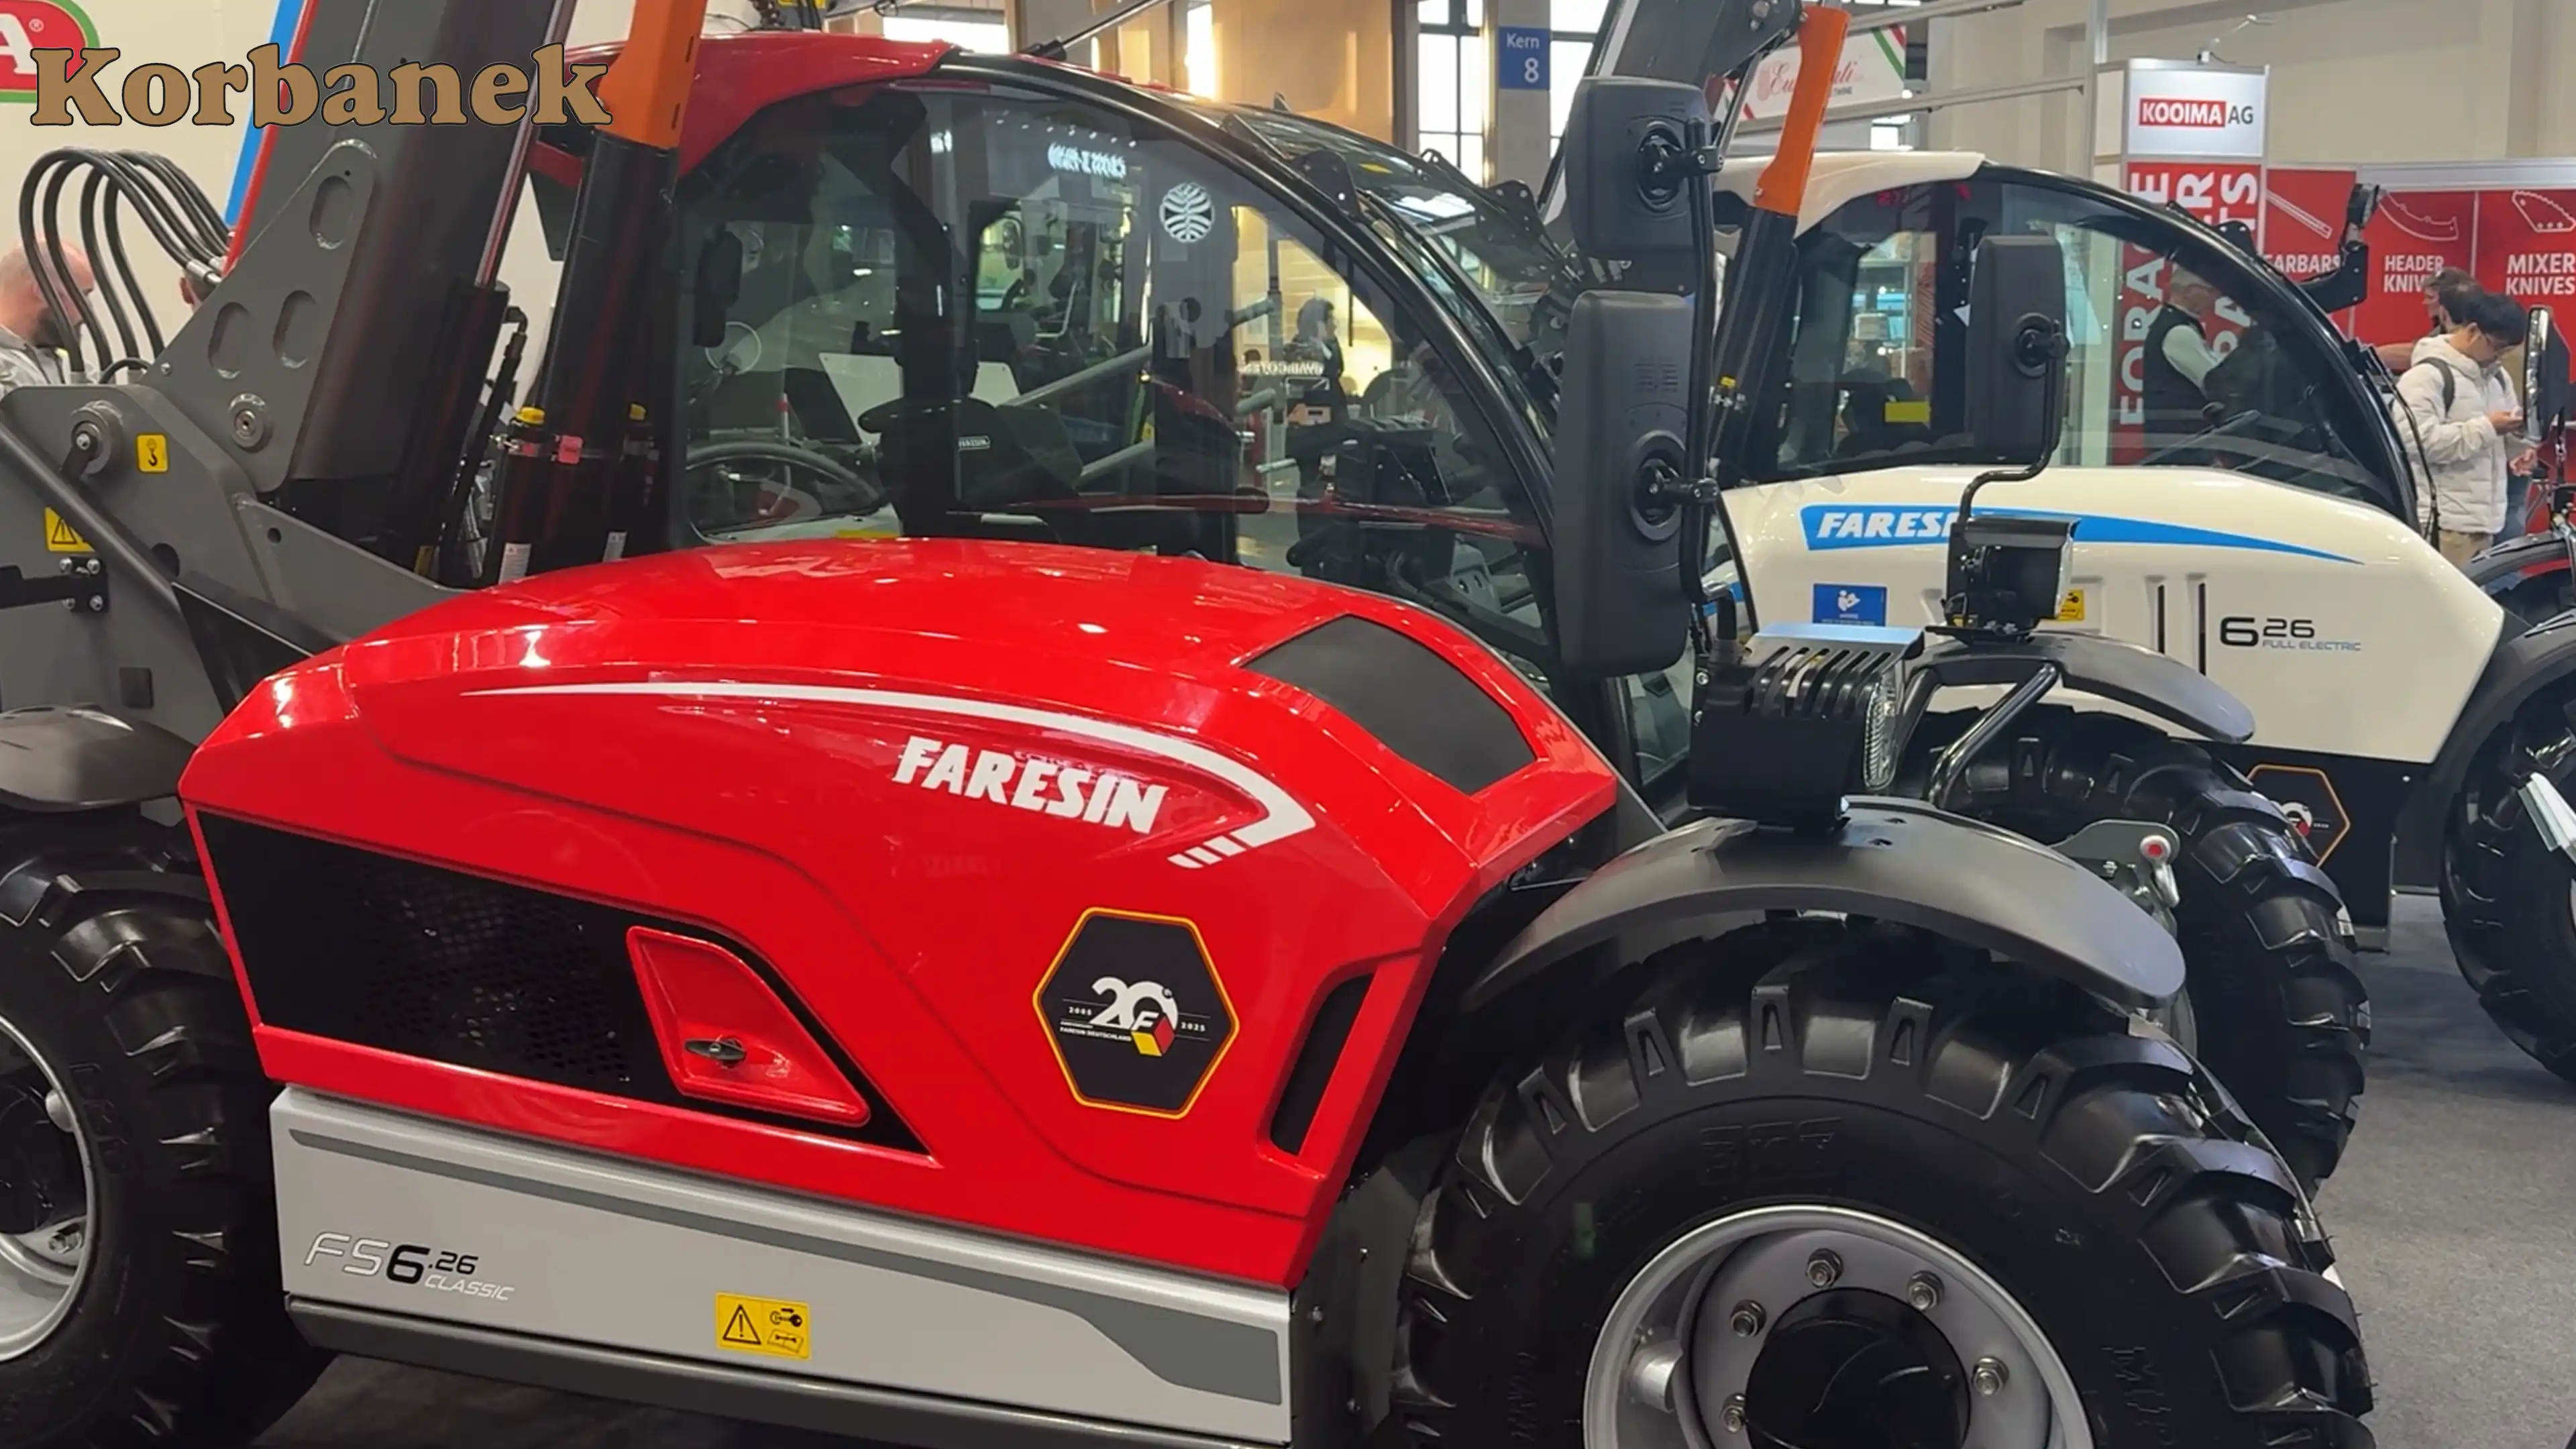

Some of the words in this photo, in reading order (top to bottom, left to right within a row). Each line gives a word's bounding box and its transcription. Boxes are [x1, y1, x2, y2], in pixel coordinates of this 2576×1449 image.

[1506, 32, 1540, 49] Kern
[1524, 57, 1540, 83] 8
[2141, 102, 2223, 125] KOOIMA
[2228, 105, 2254, 125] AG
[2385, 255, 2445, 272] HEADER
[2507, 253, 2576, 274] MIXER
[2383, 274, 2431, 293] KNIV
[2506, 276, 2576, 295] KNIVES
[2262, 639, 2296, 649] FULL
[2299, 641, 2361, 651] ELECTRIC
[892, 736, 1169, 834] FARESIN
[1181, 1022, 1206, 1032] 2025
[424, 1274, 515, 1301] CLASSIC
